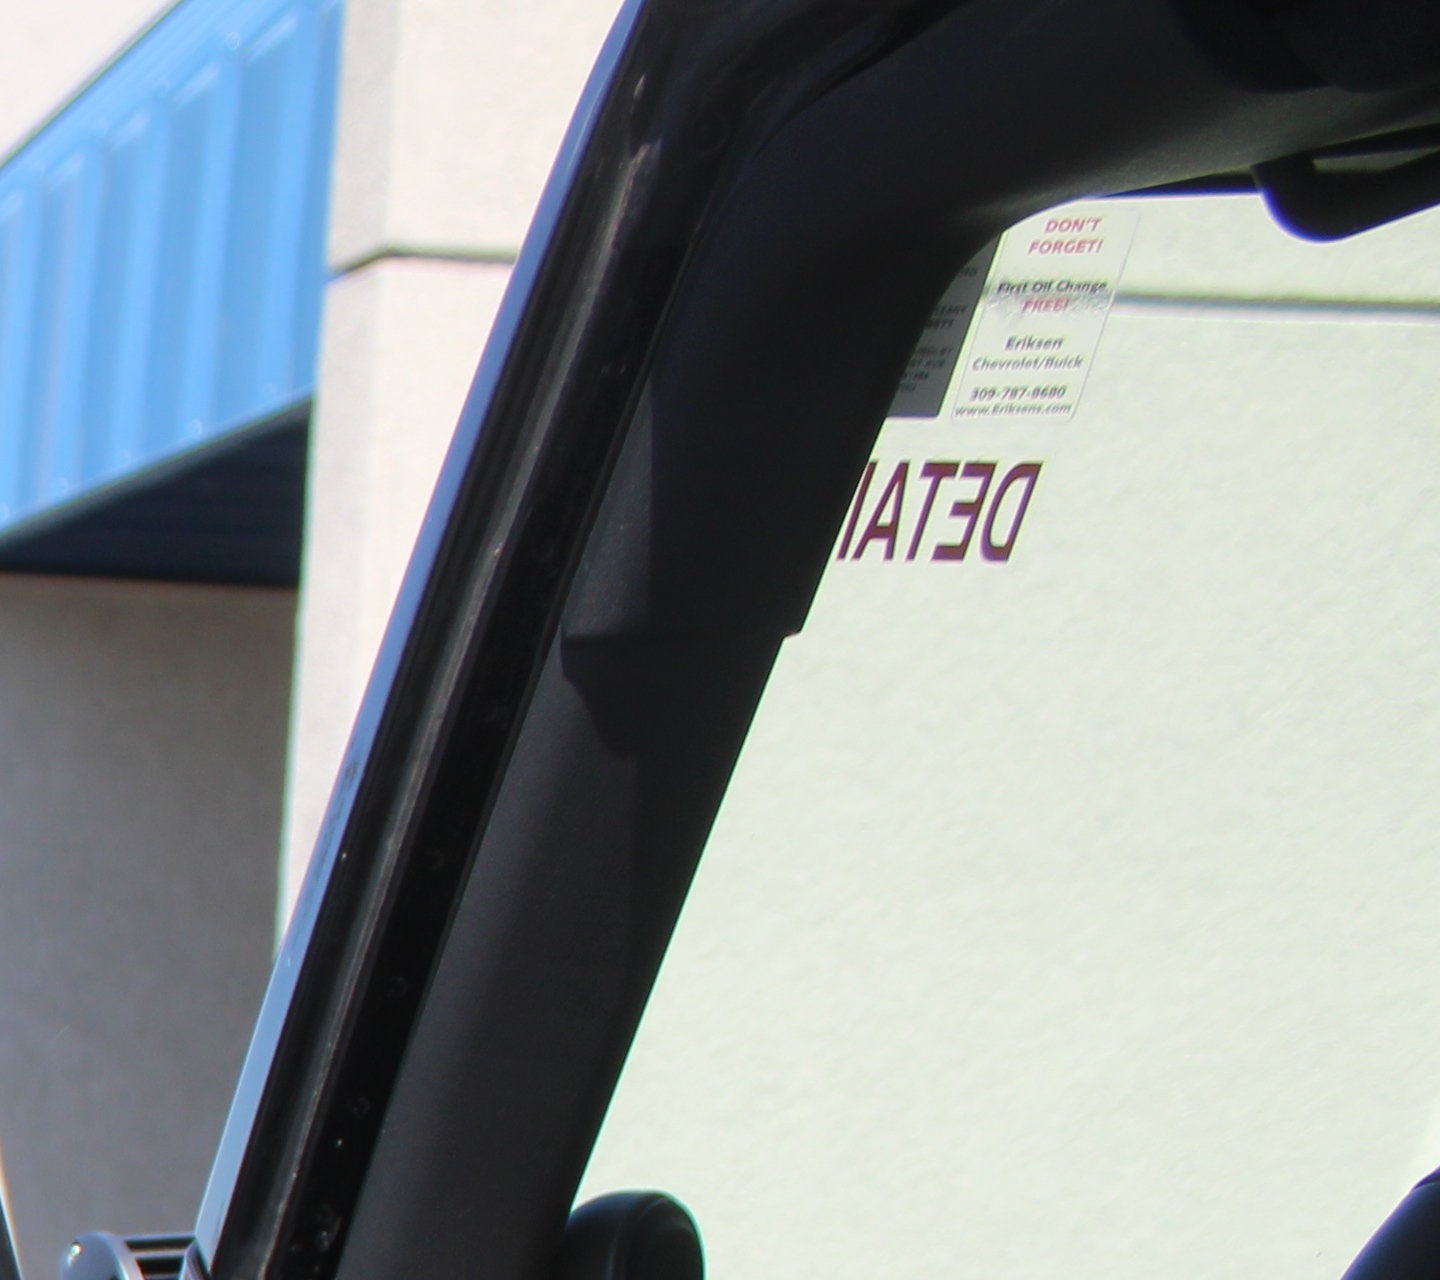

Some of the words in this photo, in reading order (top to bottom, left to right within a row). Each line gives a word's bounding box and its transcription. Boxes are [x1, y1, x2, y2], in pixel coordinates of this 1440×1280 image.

[1044, 217, 1102, 233] DON'T
[1028, 239, 1104, 255] FORGET!
[997, 282, 1029, 295] First
[1032, 281, 1053, 293] Oil
[1056, 280, 1108, 295] Change
[1005, 336, 1064, 351] Eriksen
[972, 355, 1083, 371] Chevrolet/Buick
